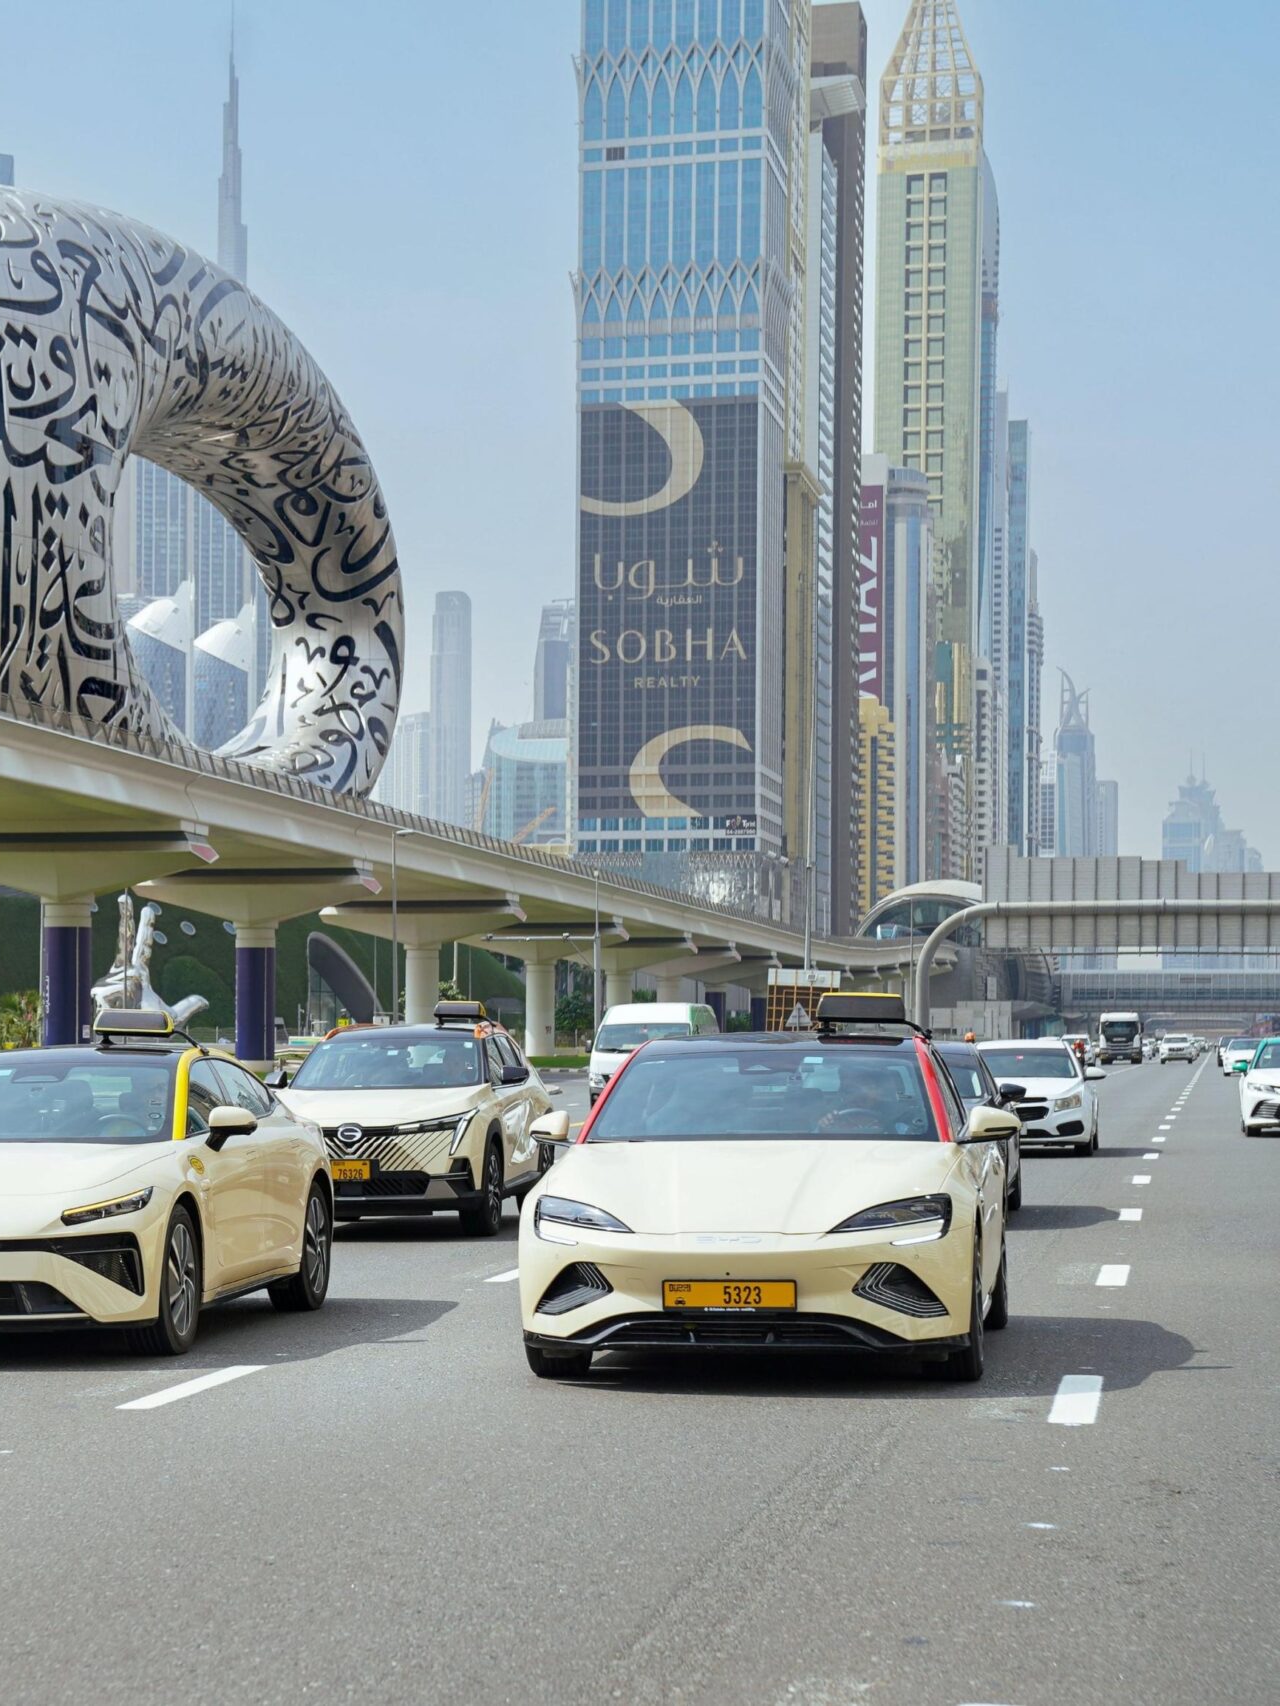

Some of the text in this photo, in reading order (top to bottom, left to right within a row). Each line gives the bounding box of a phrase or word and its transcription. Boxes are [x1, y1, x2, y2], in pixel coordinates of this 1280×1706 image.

[589, 627, 747, 664] SOBHA
[634, 675, 701, 689] REALTY
[337, 1168, 364, 1180] 76326
[723, 1285, 762, 1305] 5323
